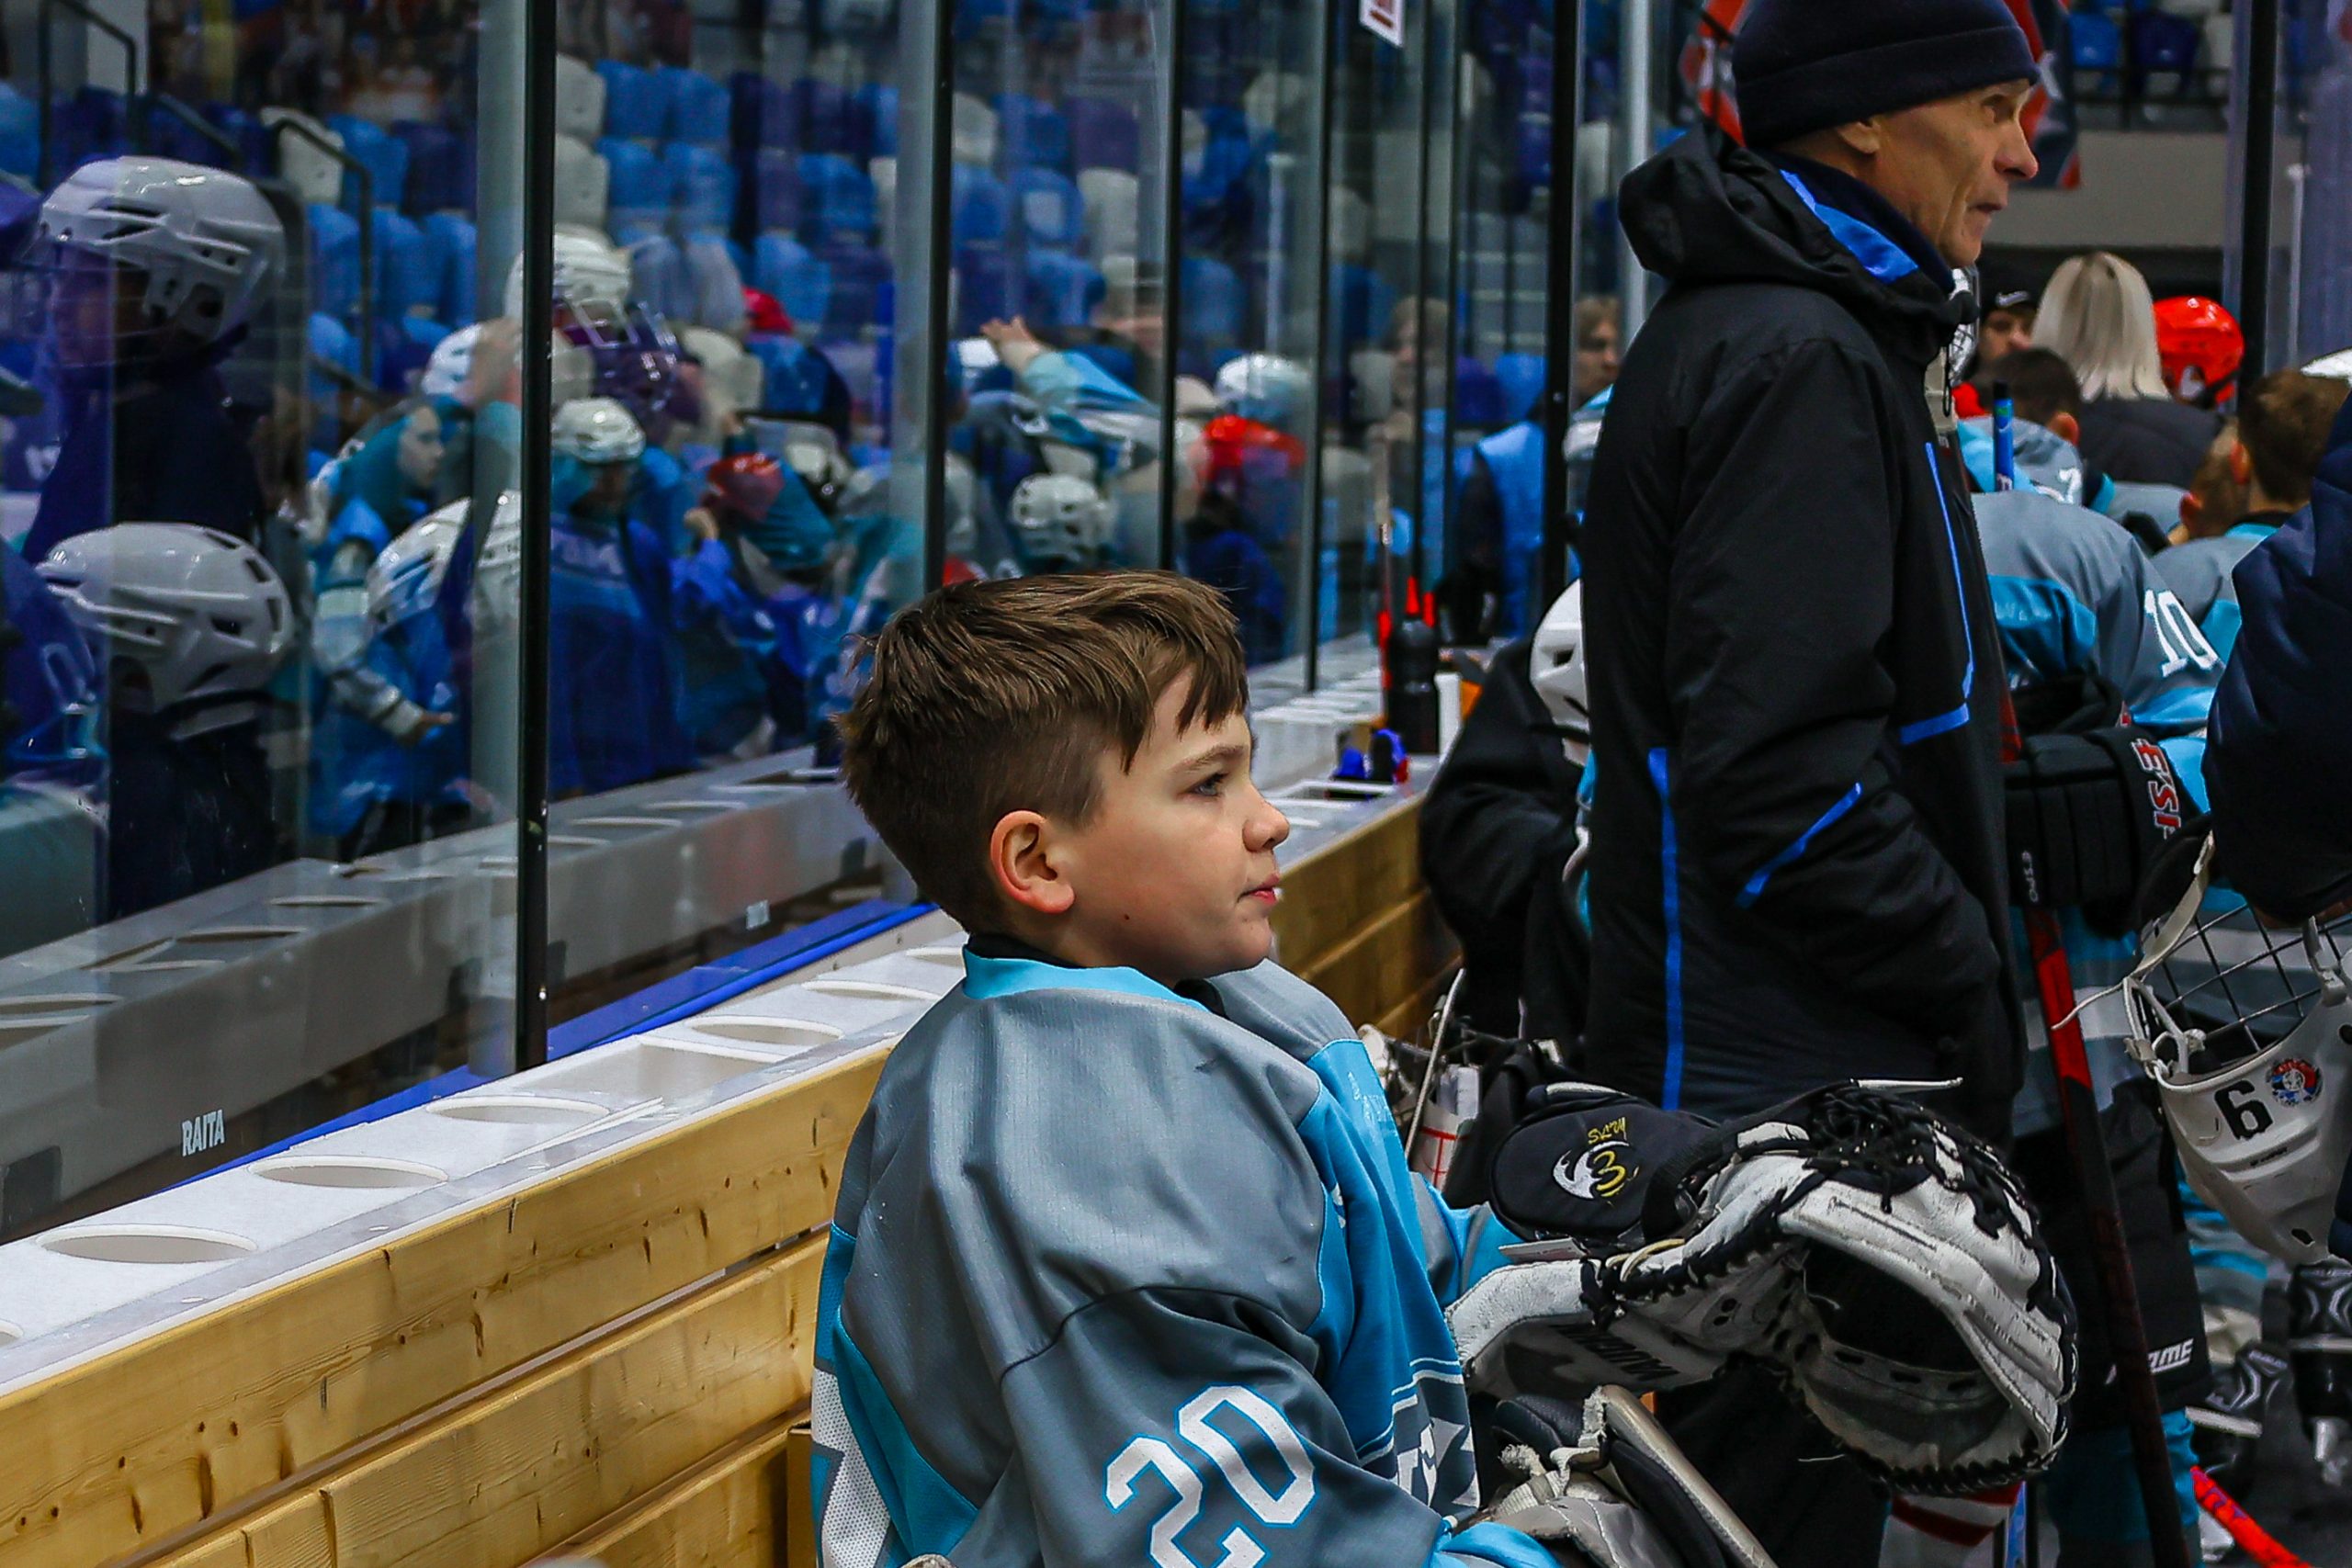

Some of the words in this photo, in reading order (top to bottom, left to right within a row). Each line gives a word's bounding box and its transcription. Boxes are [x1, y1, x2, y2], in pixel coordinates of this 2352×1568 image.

[2143, 589, 2220, 678] 10
[181, 1109, 226, 1157] RAITA
[2214, 1079, 2274, 1140] 6
[1103, 1383, 1317, 1568] 20
